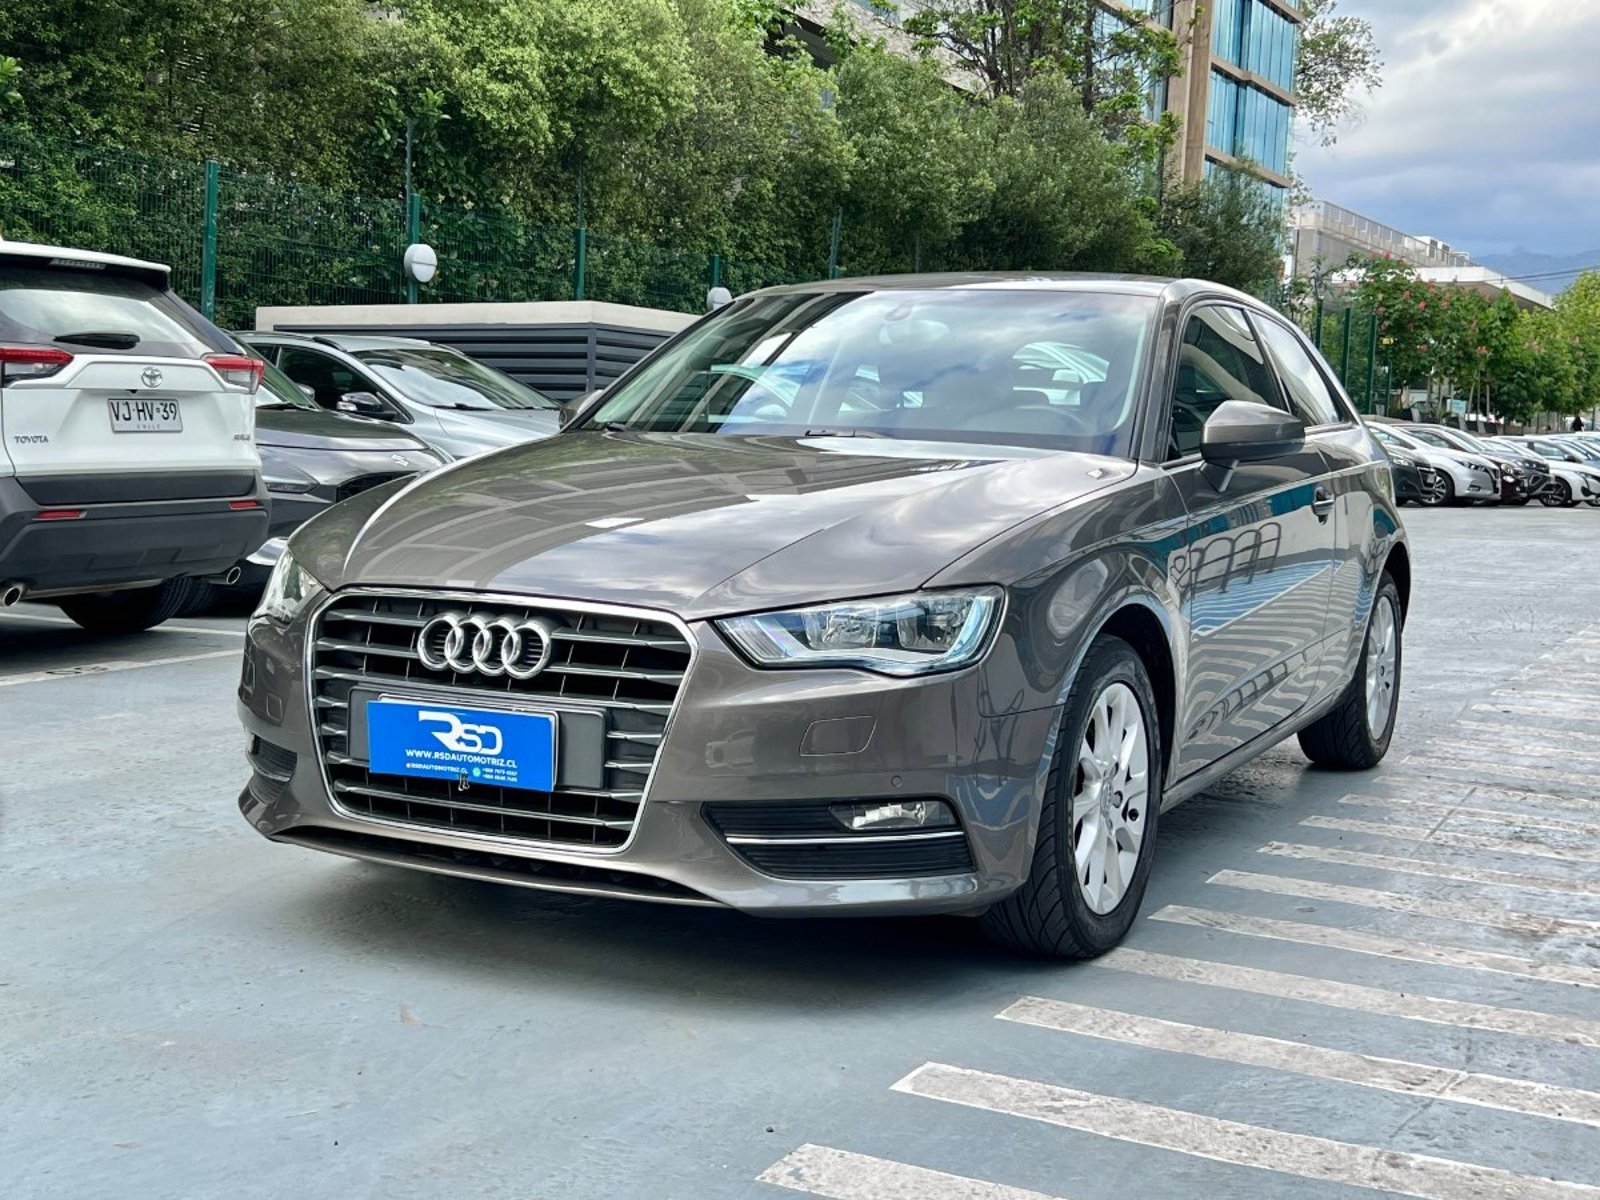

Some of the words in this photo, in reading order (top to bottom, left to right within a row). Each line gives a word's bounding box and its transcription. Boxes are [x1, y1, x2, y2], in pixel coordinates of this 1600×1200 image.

[14, 435, 49, 443] TOYOTA
[418, 711, 503, 755] RSD
[405, 749, 518, 768] WWW.RSDAUTOMOTRIZ.CL
